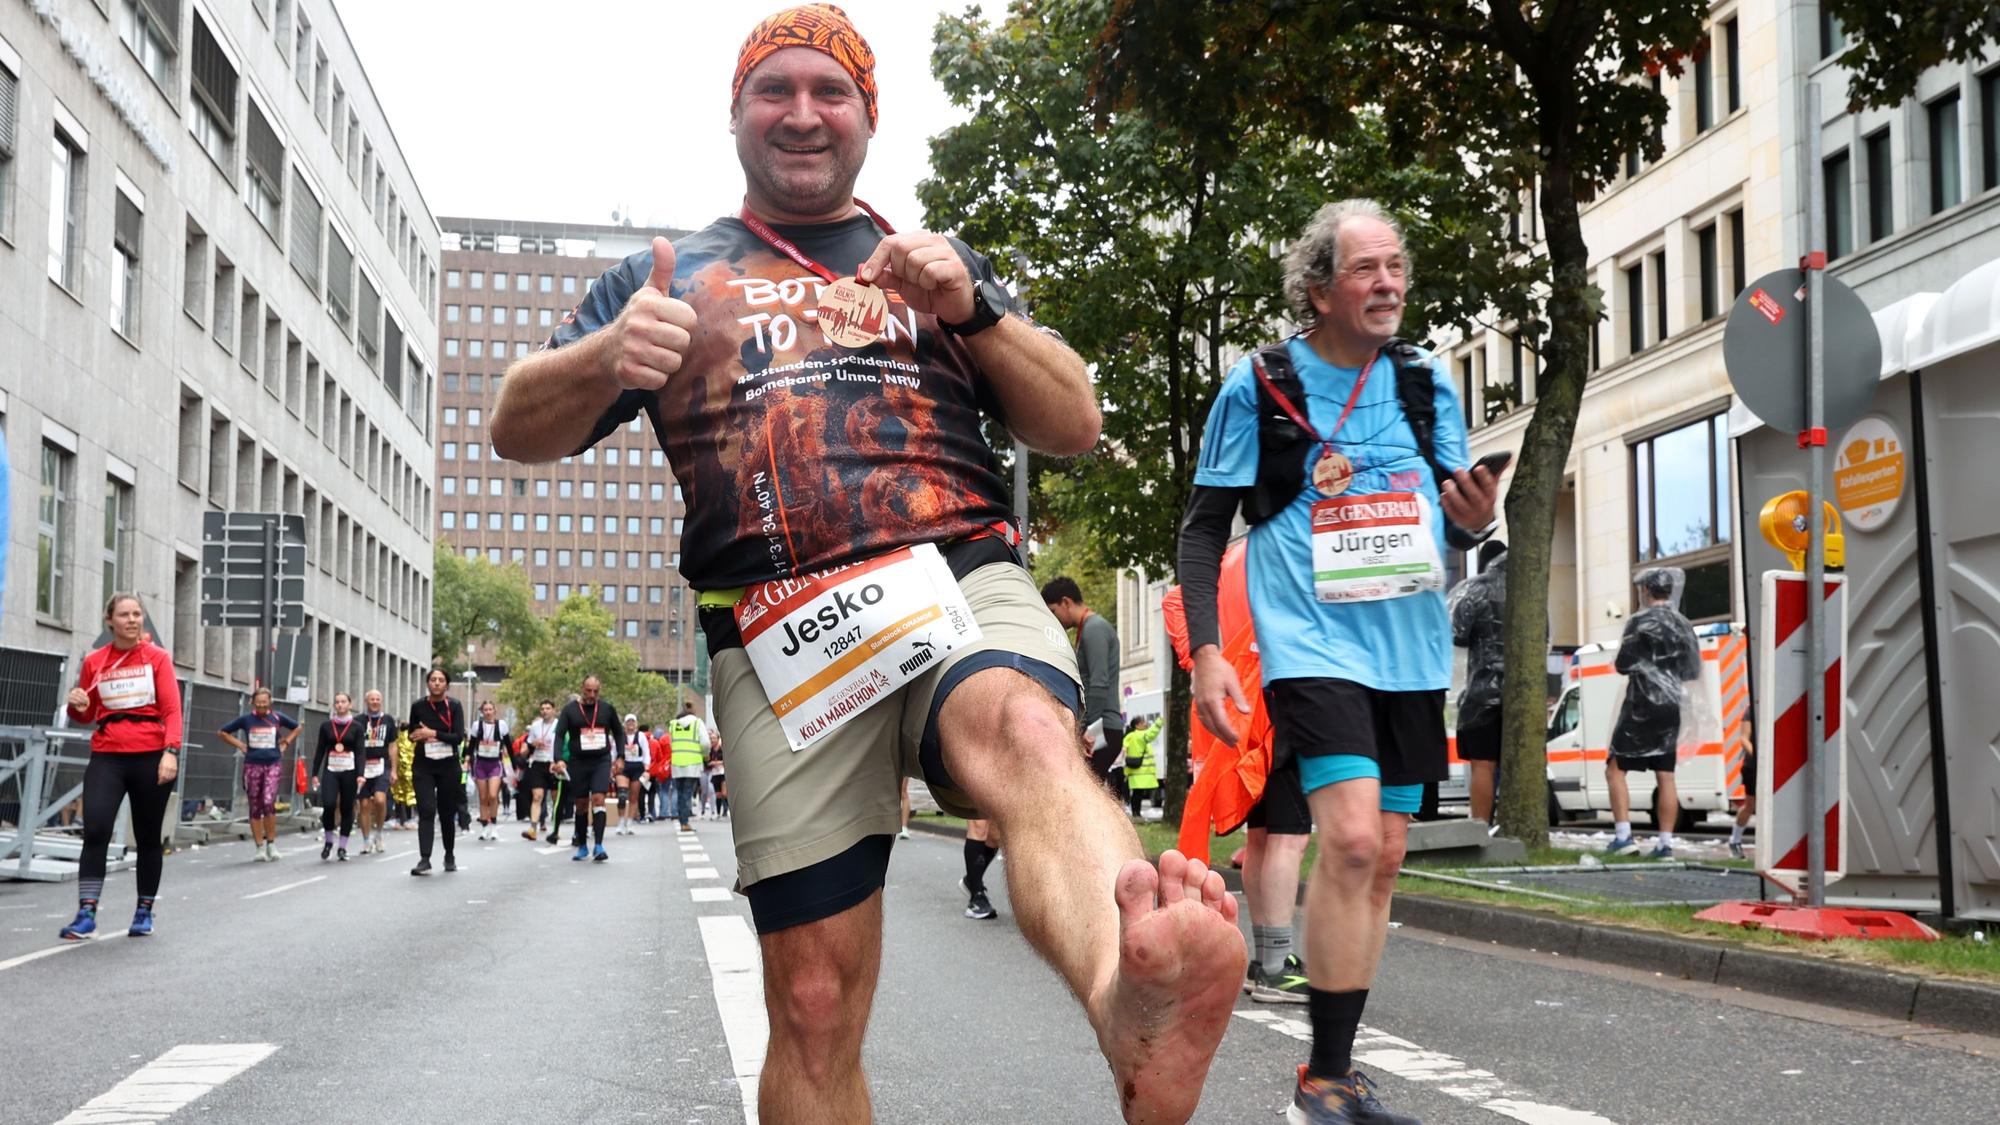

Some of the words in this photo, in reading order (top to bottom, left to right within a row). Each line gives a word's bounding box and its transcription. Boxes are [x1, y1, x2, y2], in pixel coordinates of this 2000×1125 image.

[737, 312, 797, 353] TO
[745, 371, 832, 401] Bornekamp
[836, 369, 882, 384] Unna,
[885, 375, 921, 390] NRW
[1331, 532, 1413, 554] Jürgen
[781, 583, 884, 657] Jesko
[945, 605, 968, 636] 12847
[823, 625, 863, 660] 12847
[870, 626, 902, 650] Startblock
[899, 648, 933, 676] PUMA
[110, 681, 134, 690] Lena
[837, 675, 868, 700] GENERALI
[780, 698, 793, 711] 21.1
[799, 715, 827, 741] KÖLN
[824, 683, 878, 725] MARATHON
